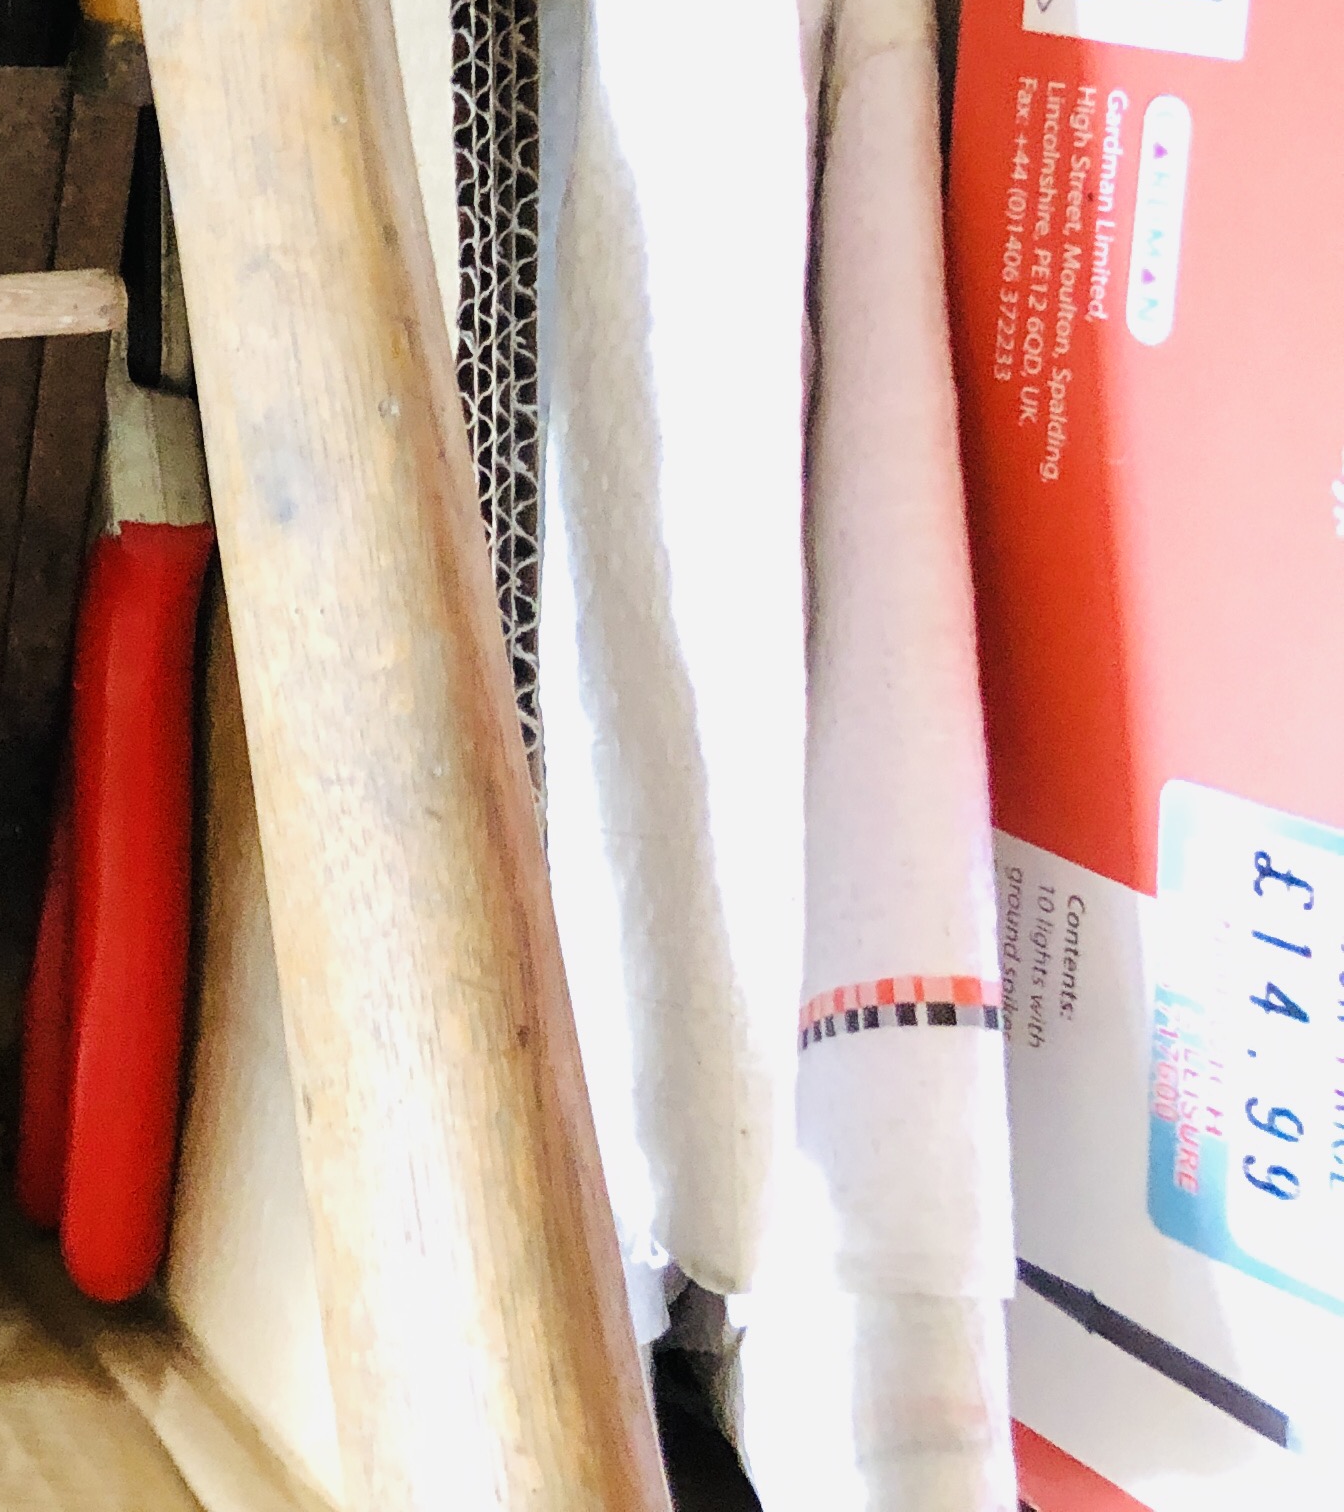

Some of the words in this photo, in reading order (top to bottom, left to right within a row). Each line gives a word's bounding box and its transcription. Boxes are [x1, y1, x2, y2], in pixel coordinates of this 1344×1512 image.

[1069, 85, 1097, 148] High
[1011, 135, 1031, 181] +44
[1096, 89, 1128, 213] Gardman
[1027, 246, 1054, 312] PE12
[1004, 867, 1023, 964] ground
[1038, 886, 1055, 913] 10
[1030, 916, 1054, 988] lights
[1059, 894, 1086, 1021] Contents:
[1029, 994, 1047, 1048] with
